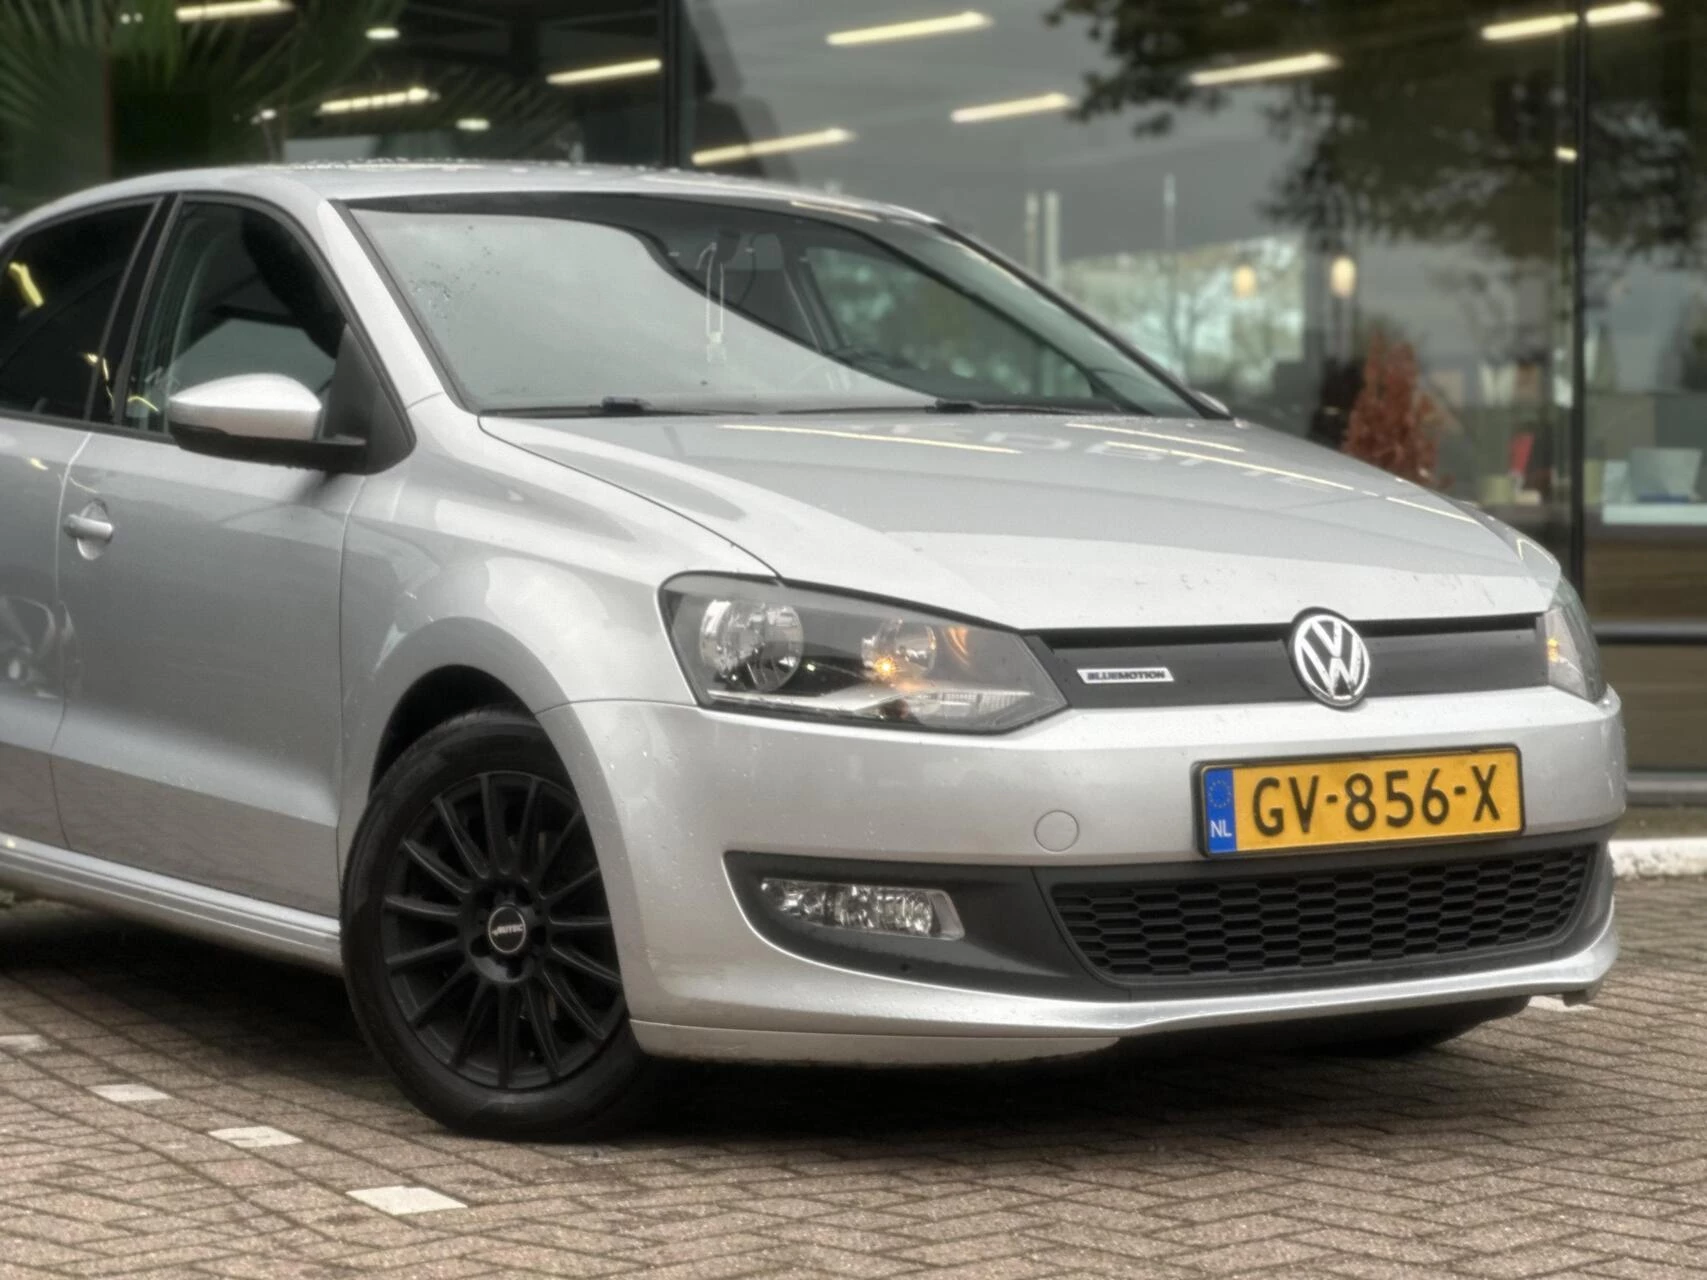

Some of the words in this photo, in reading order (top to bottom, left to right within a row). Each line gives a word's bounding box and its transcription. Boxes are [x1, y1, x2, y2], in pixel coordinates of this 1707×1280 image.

[1086, 671, 1166, 681] BLUEMOTION
[1252, 763, 1501, 837] GV-856-X
[1210, 819, 1233, 838] NL
